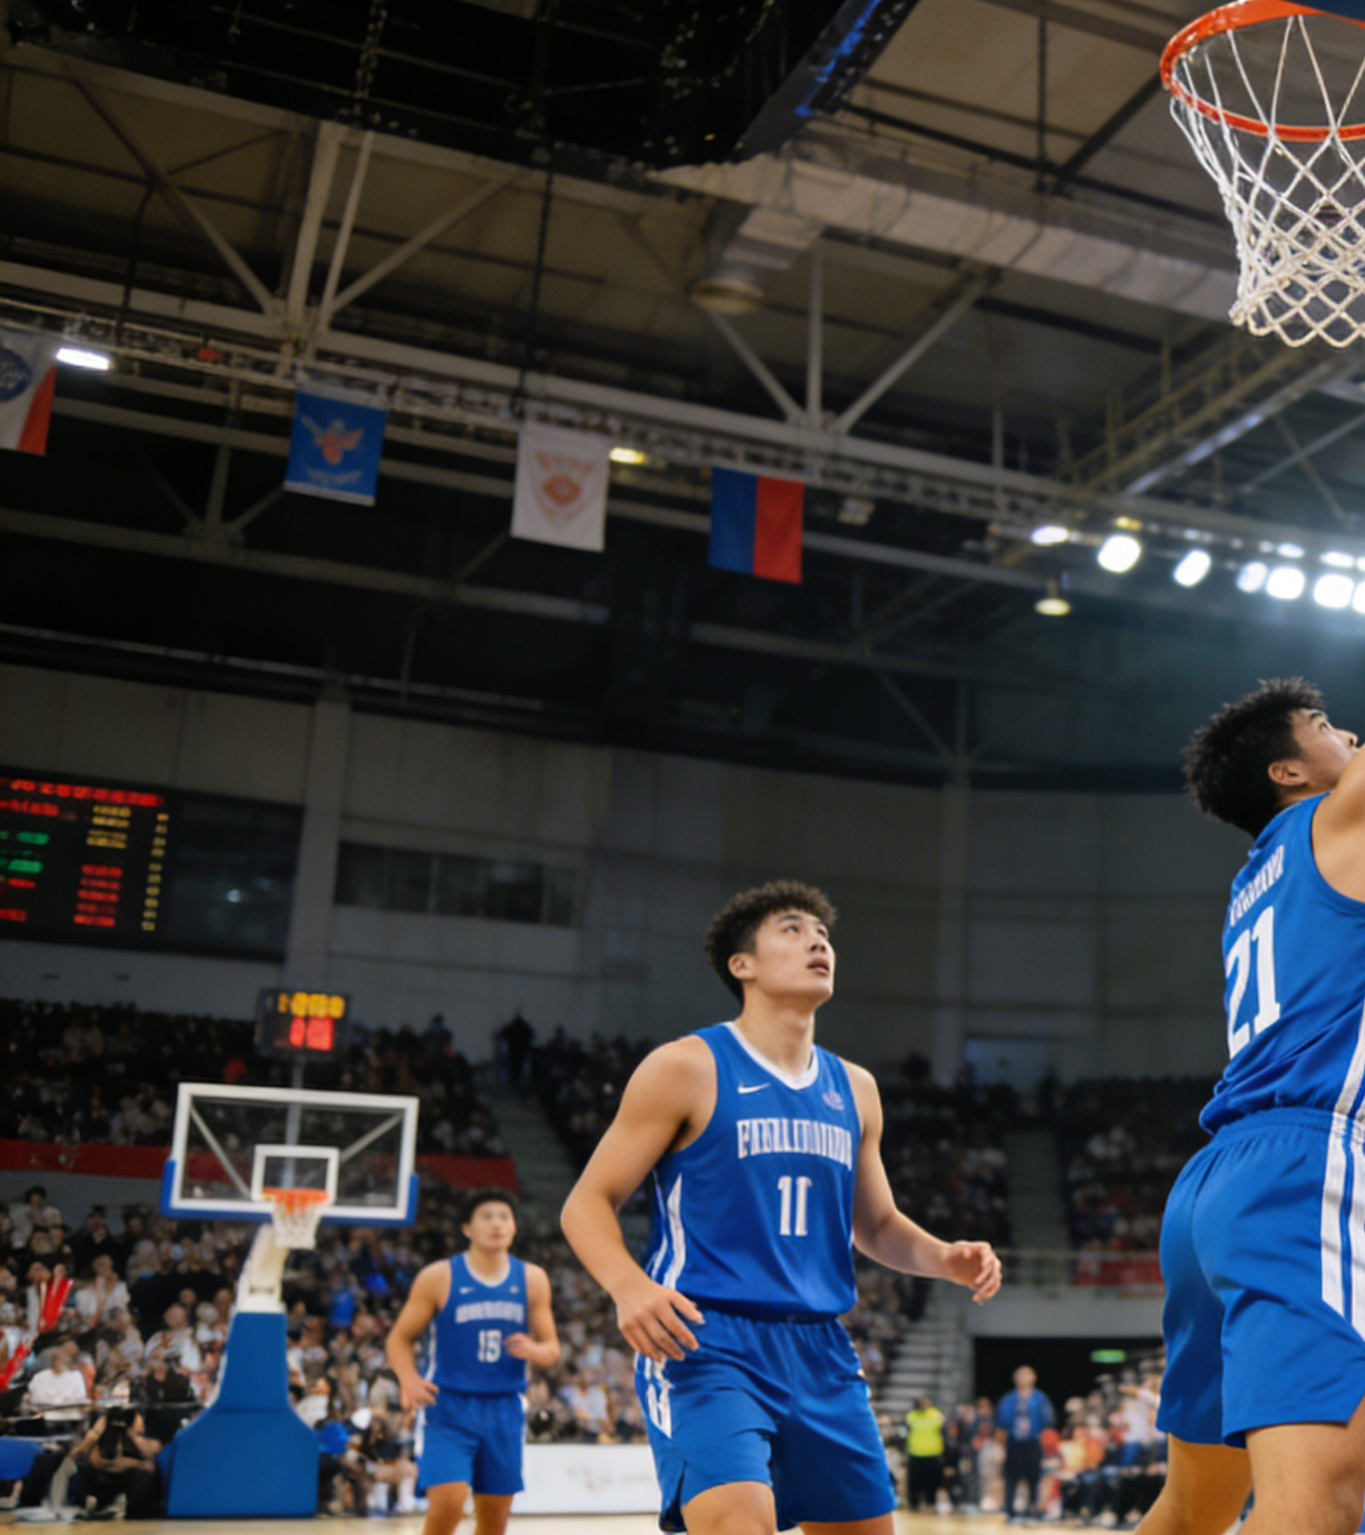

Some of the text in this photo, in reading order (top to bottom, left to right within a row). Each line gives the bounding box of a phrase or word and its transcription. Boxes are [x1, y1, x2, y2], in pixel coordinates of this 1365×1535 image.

[1226, 906, 1281, 1060] 21
[777, 1176, 812, 1236] 11
[477, 1329, 502, 1363] 15
